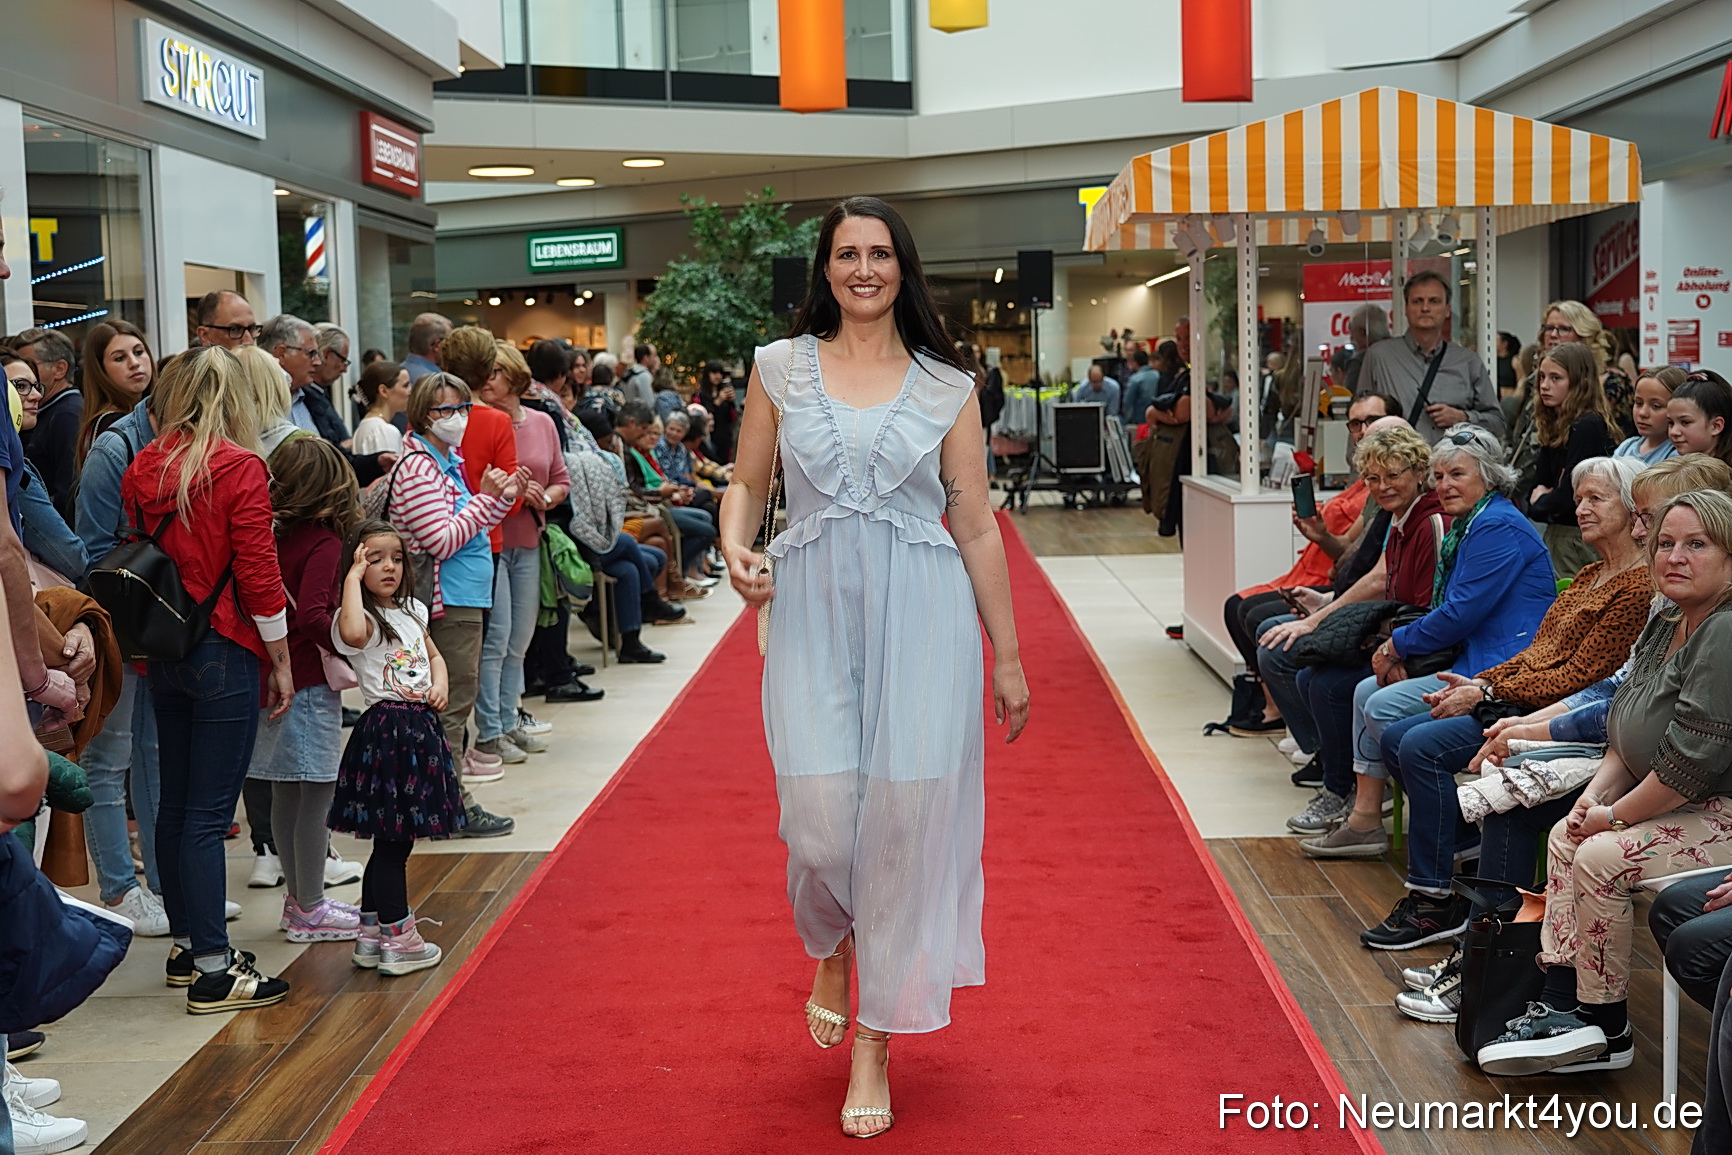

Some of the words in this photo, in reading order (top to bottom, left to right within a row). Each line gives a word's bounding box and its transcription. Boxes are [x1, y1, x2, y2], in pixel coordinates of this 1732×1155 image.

[161, 38, 259, 126] STARCUT
[536, 241, 612, 259] LEBENSRAUM
[1677, 281, 1730, 293] Abholung
